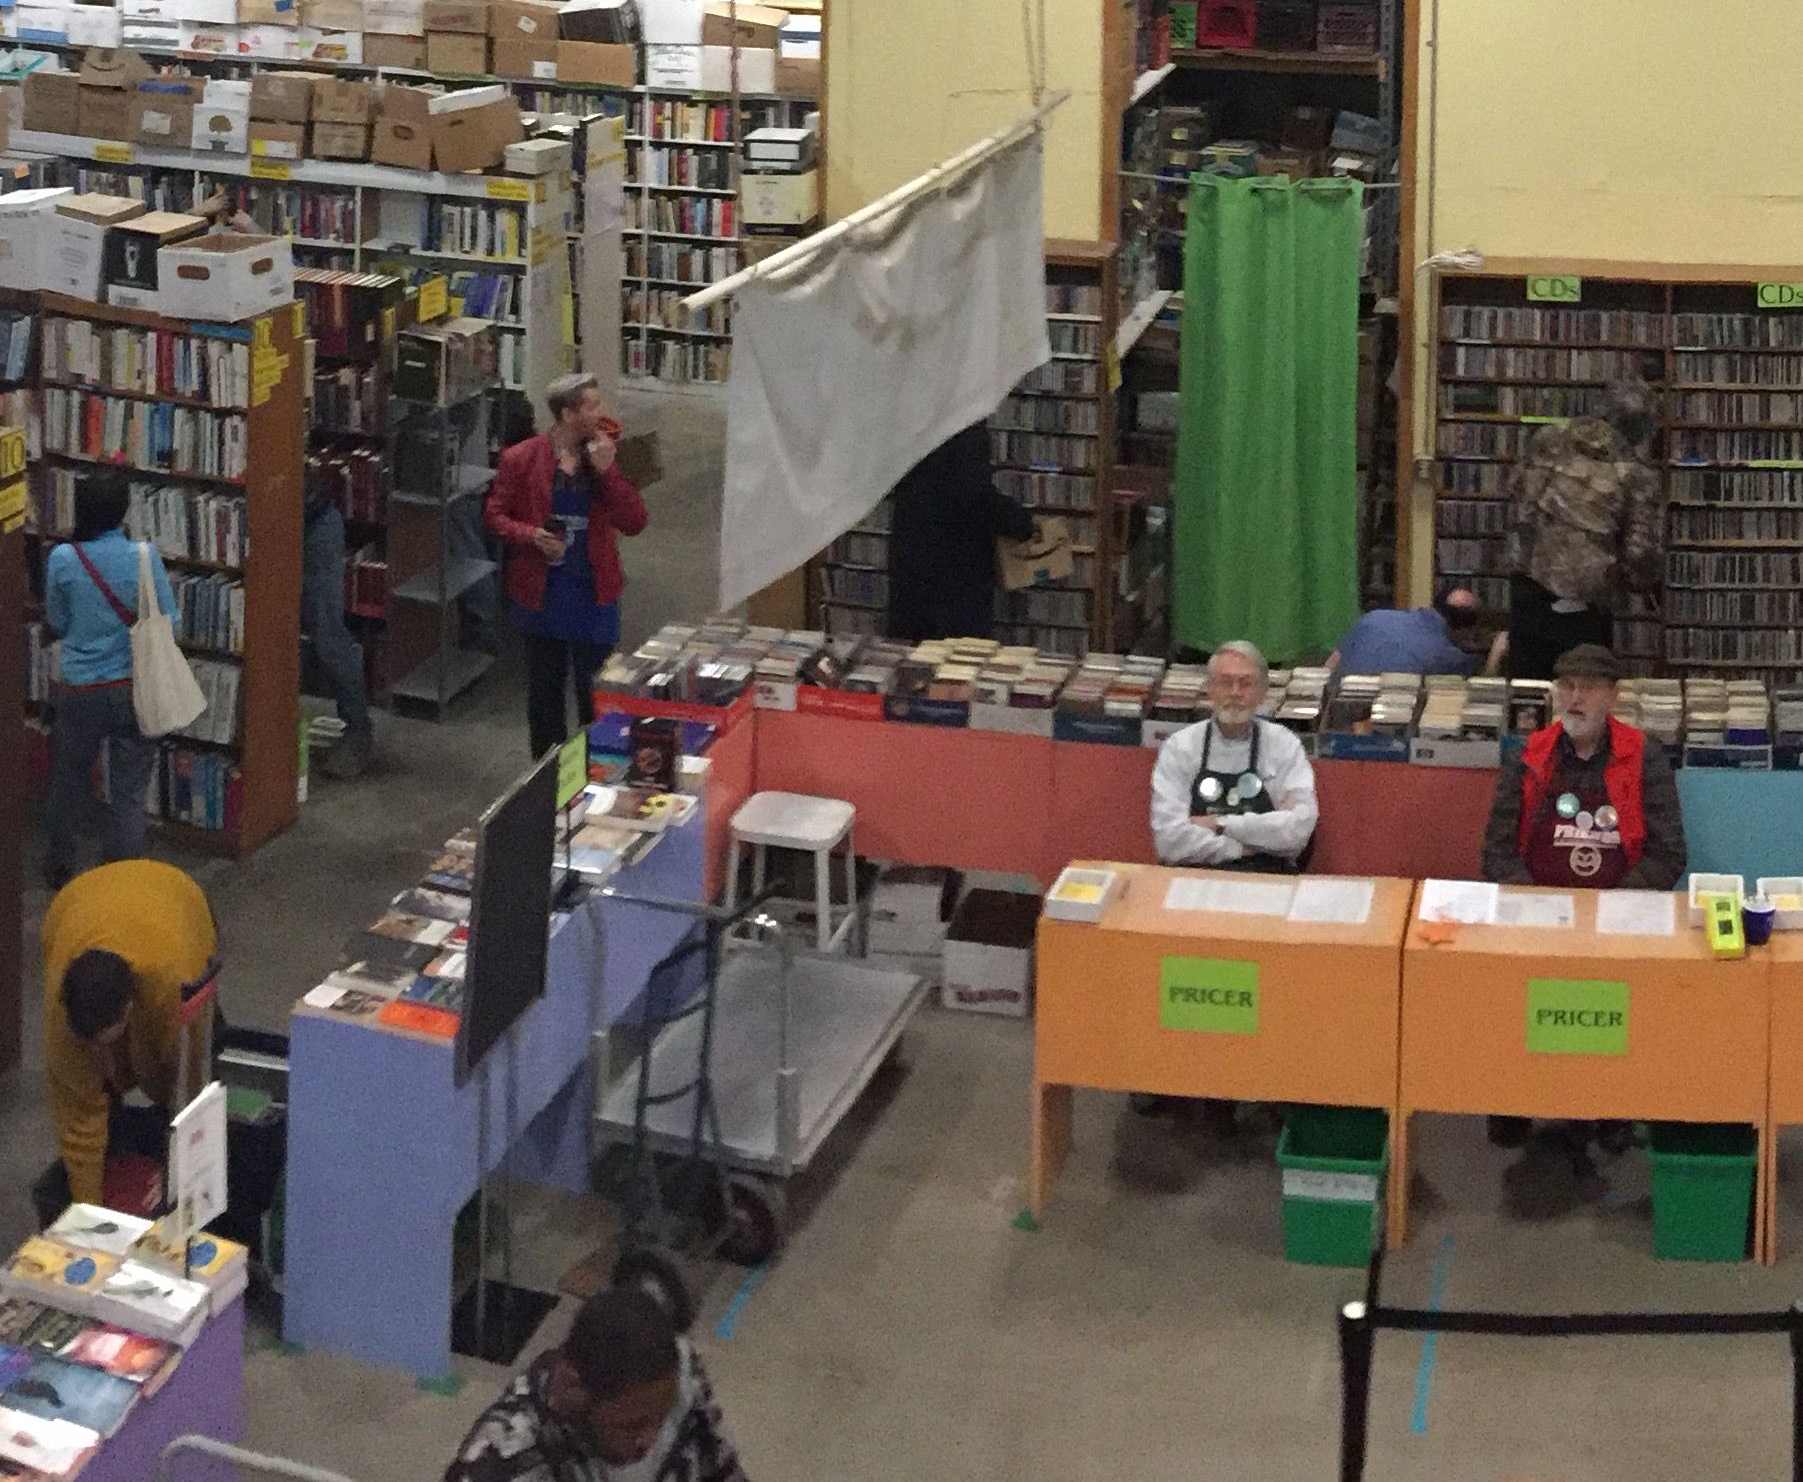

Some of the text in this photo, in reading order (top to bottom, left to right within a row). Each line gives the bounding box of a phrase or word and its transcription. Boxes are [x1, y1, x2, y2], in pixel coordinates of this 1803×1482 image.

[1532, 278, 1577, 298] CDs
[2, 438, 24, 473] 10
[1168, 981, 1253, 1007] PRICER
[1535, 1004, 1623, 1028] PRICER
